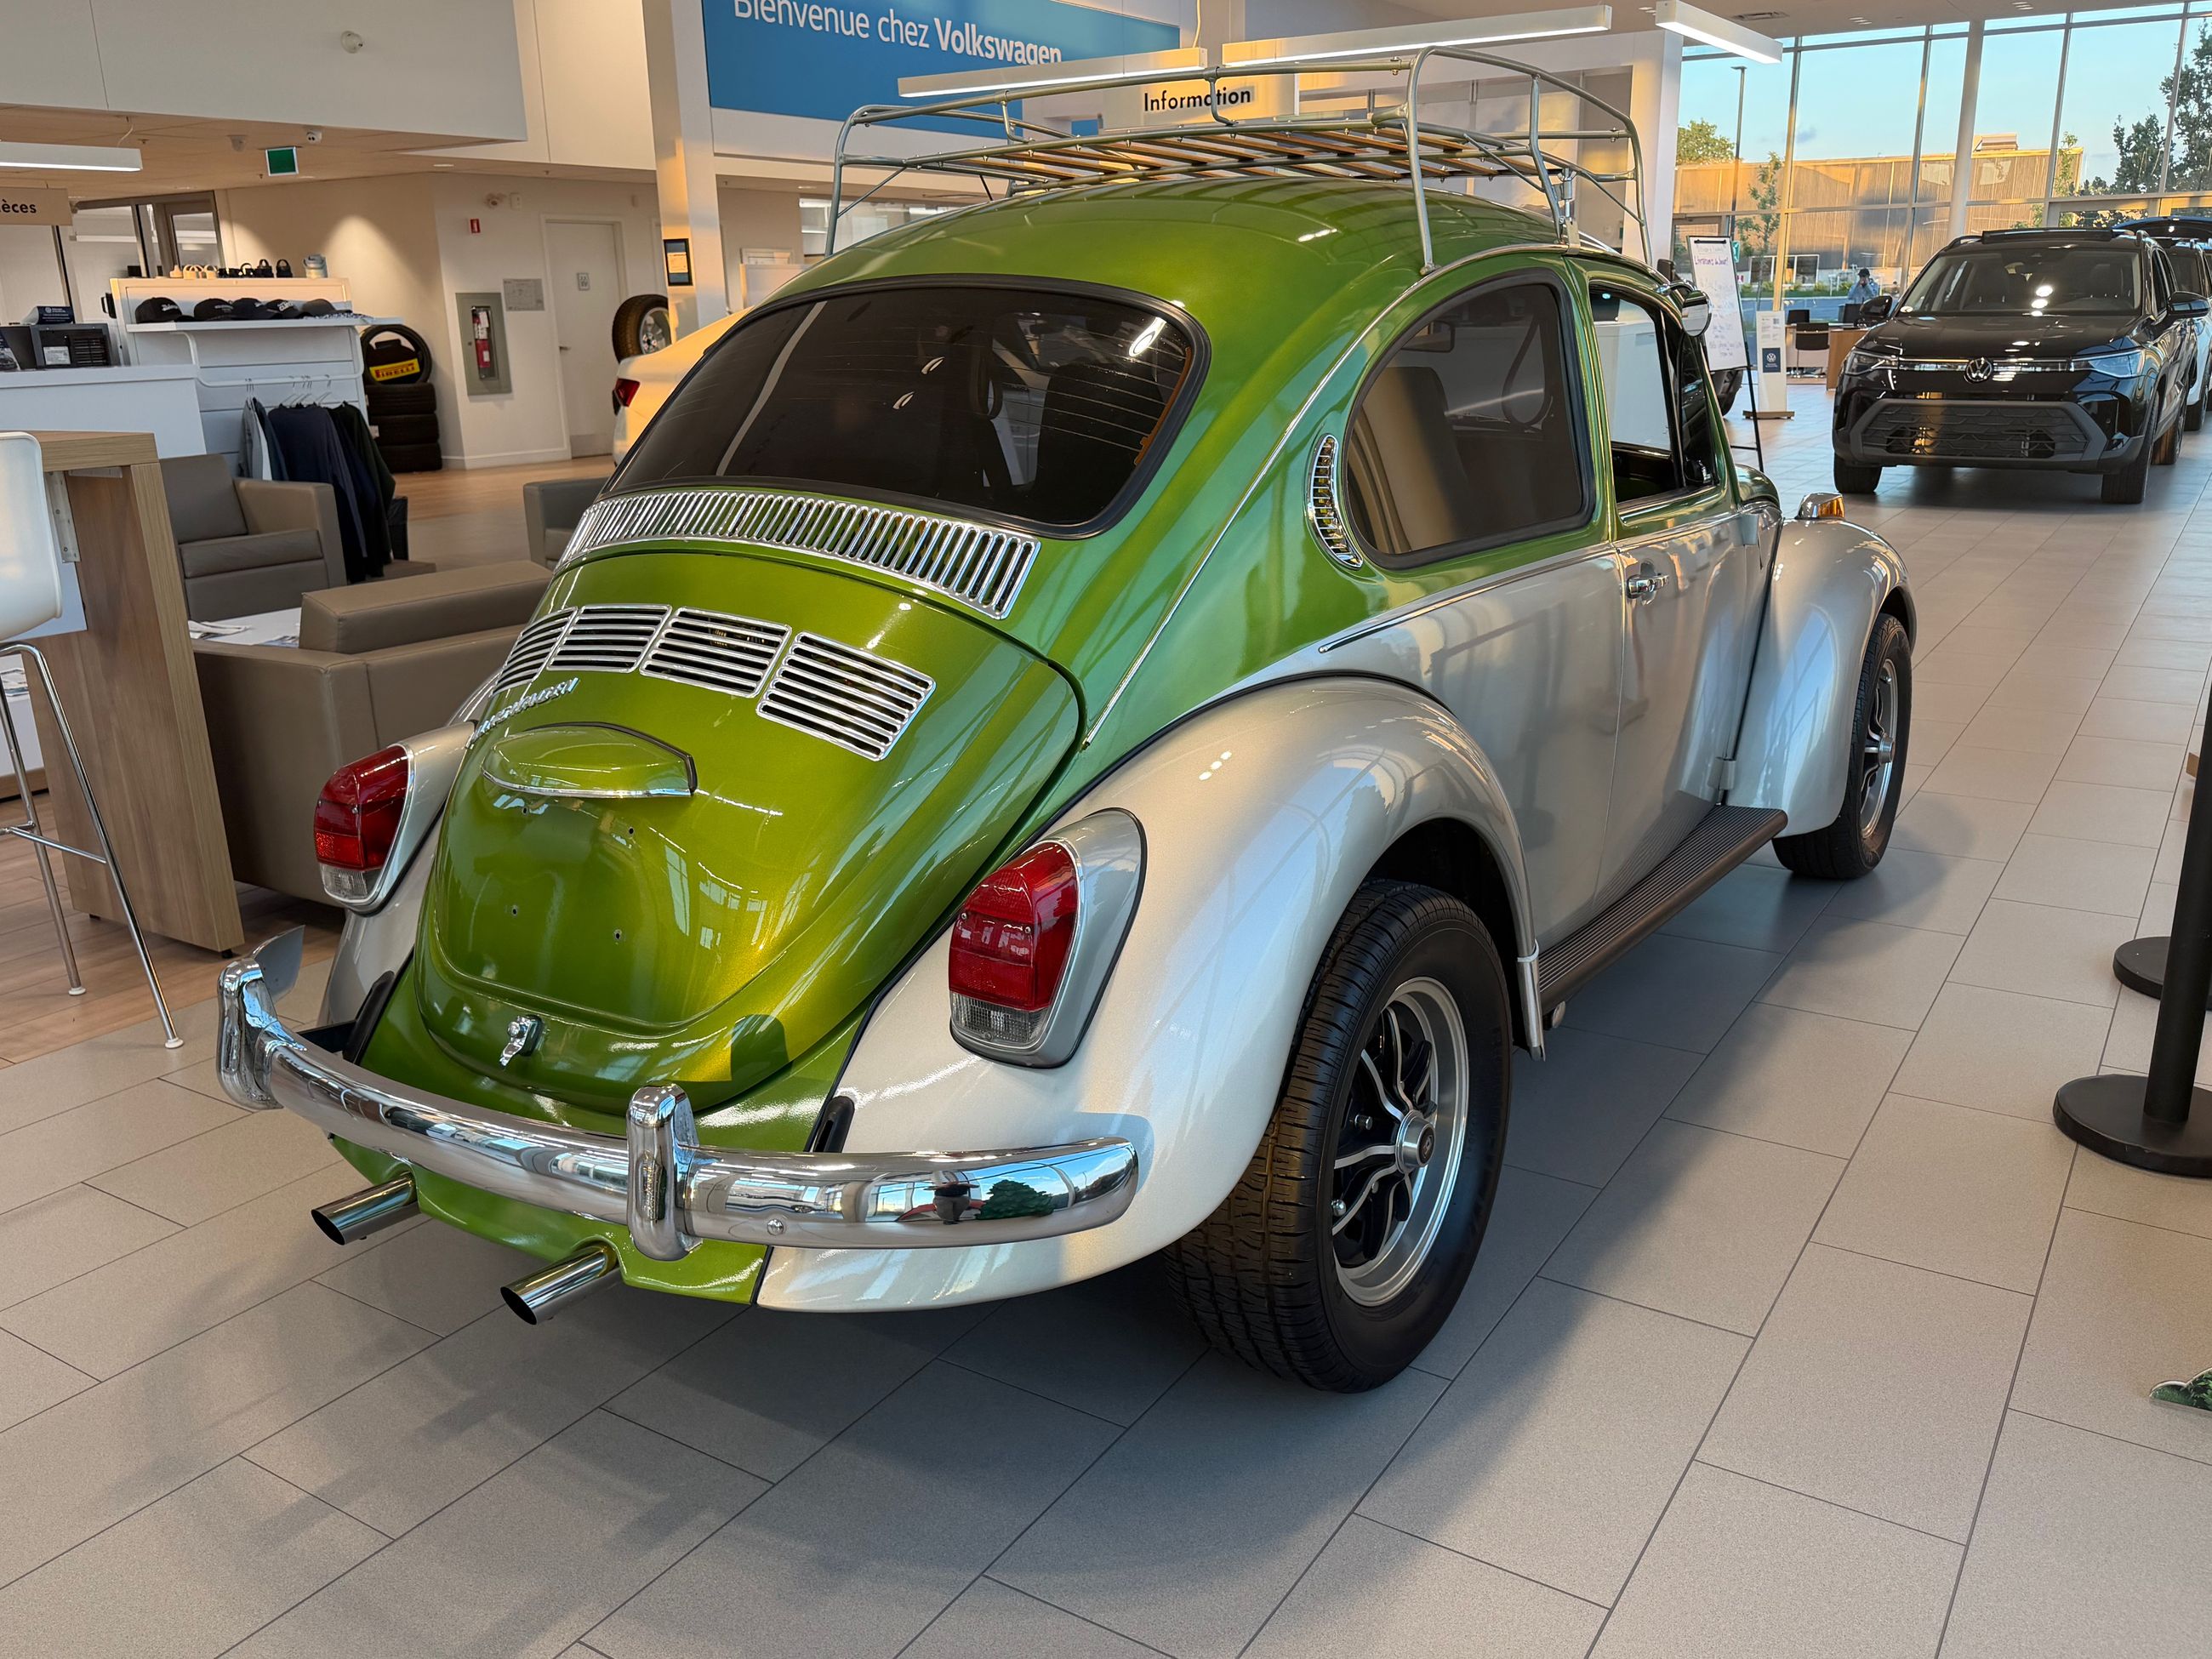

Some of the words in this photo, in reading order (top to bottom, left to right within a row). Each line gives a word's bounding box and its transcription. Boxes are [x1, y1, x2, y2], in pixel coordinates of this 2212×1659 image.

[734, 0, 869, 38] Bienvenue
[877, 9, 930, 48] chez
[934, 18, 1062, 66] Volkswagen
[1144, 87, 1251, 111] Information
[0, 199, 37, 214] èces
